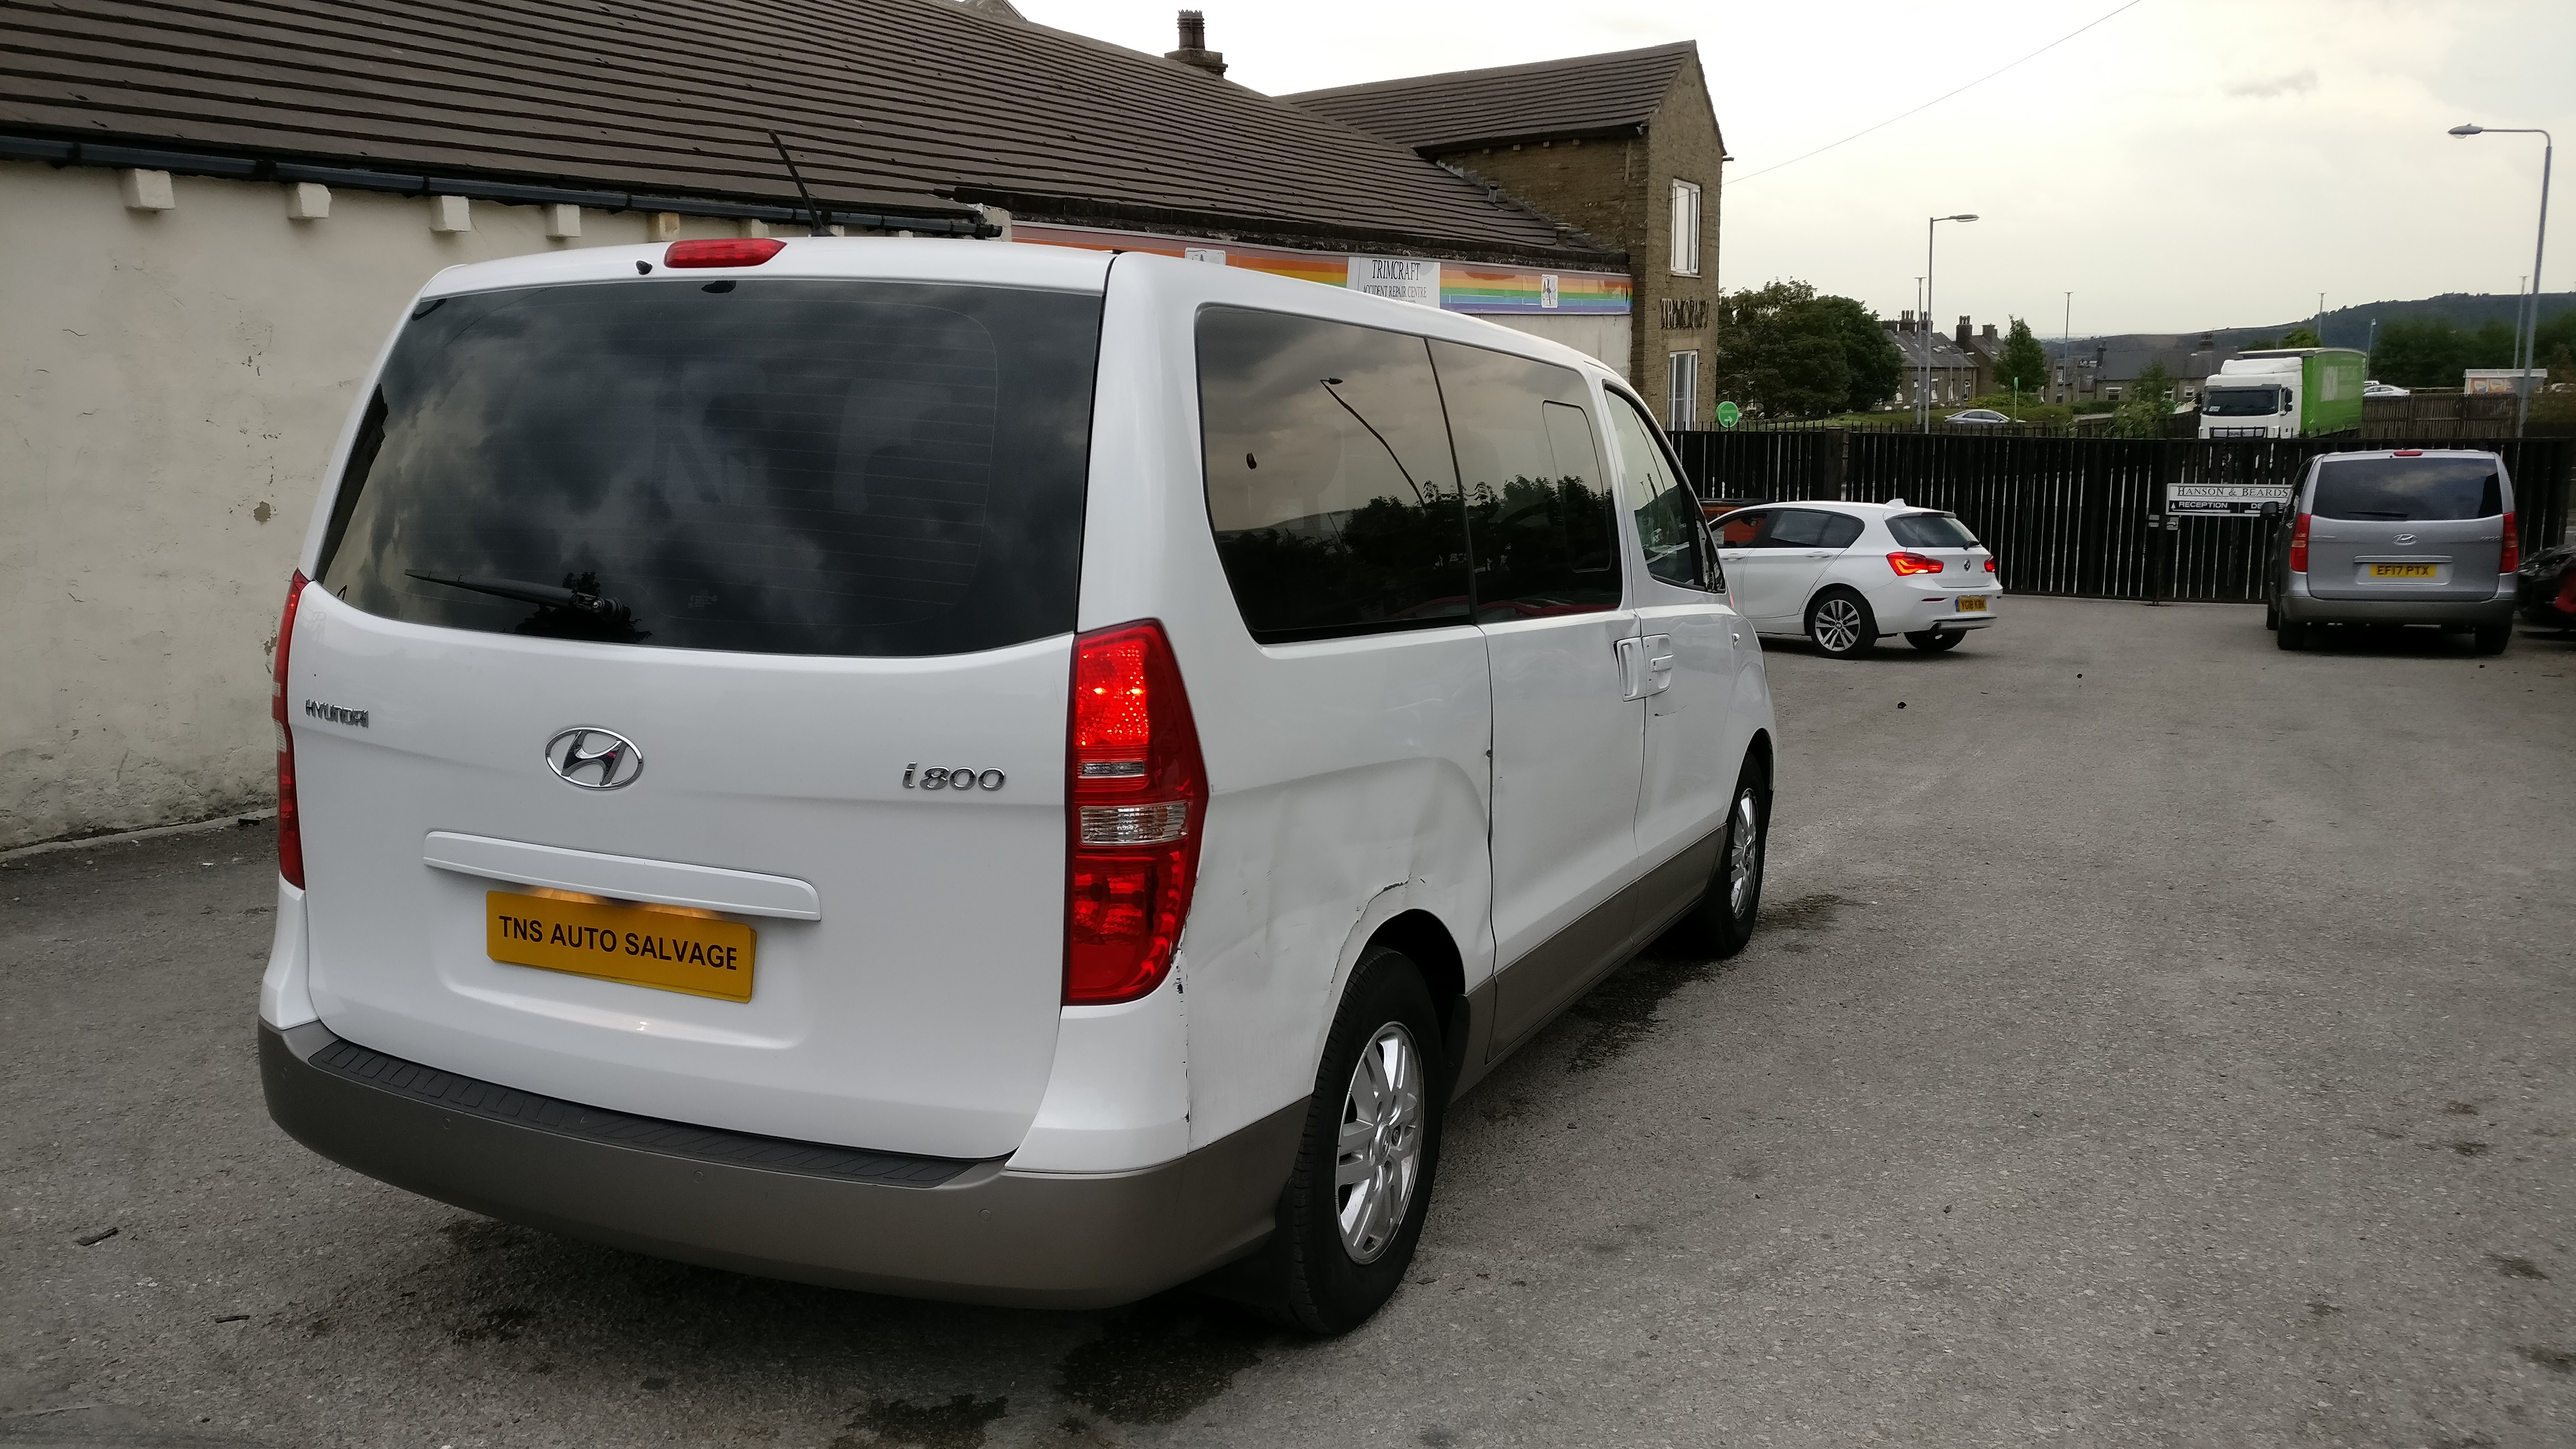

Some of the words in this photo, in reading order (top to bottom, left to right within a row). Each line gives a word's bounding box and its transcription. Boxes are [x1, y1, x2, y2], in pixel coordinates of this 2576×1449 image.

[1372, 259, 1421, 280] TRIMCRAFT
[1362, 284, 1388, 298] ACCIDENT
[1388, 285, 1407, 298] REPAIR
[1407, 286, 1427, 298] CENTRE
[2177, 486, 2225, 496] HANSON
[2228, 488, 2237, 496] &
[2377, 566, 2403, 576] EF17
[2406, 566, 2429, 576] PTX
[305, 698, 369, 728] HYUNDAI
[902, 762, 1006, 791] i800
[499, 915, 543, 943] TNS
[550, 923, 617, 952] AUTO
[625, 932, 737, 971] SALVAGE
